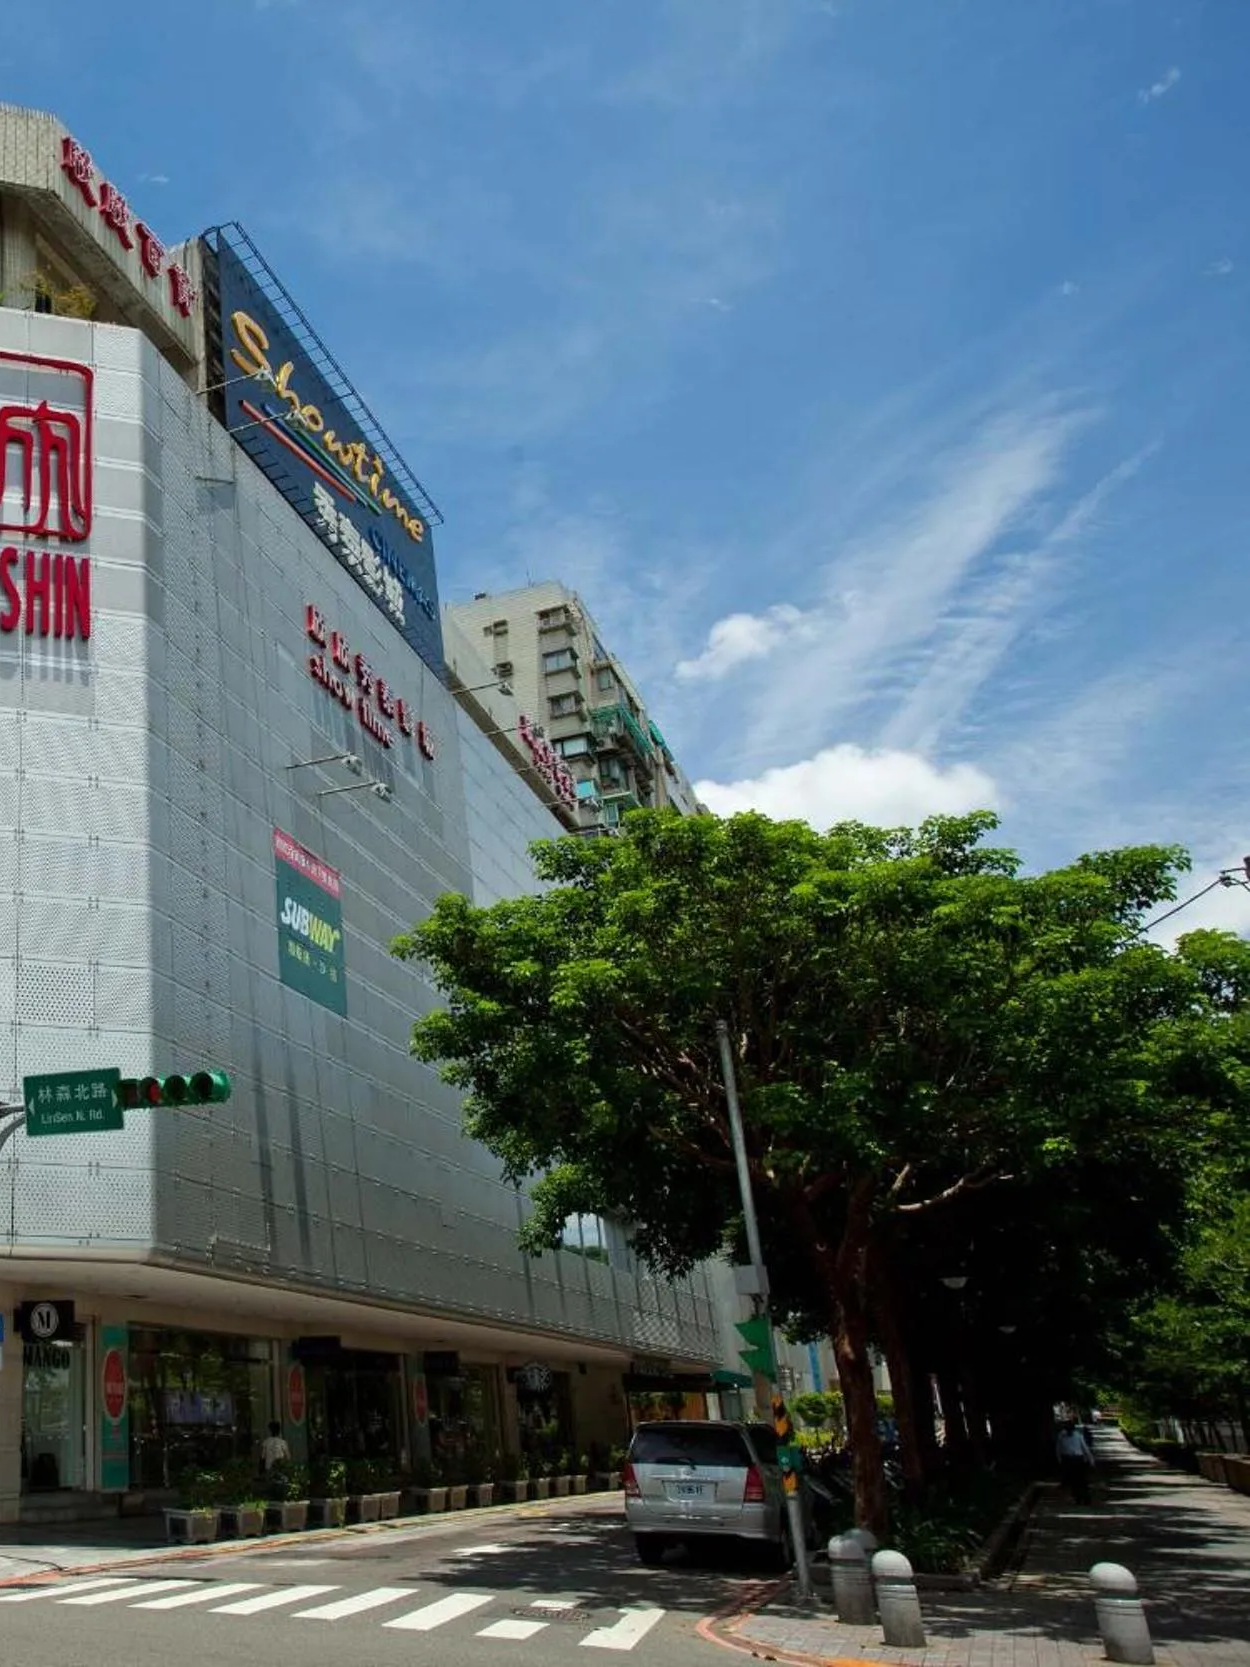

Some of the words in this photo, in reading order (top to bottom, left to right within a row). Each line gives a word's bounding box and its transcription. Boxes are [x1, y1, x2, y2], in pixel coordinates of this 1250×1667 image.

[230, 311, 424, 542] Showtime
[281, 897, 341, 953] SUBWAY
[37, 1083, 108, 1103] 林森北路
[88, 1109, 104, 1121] Rd.
[23, 1345, 70, 1369] MANGO
